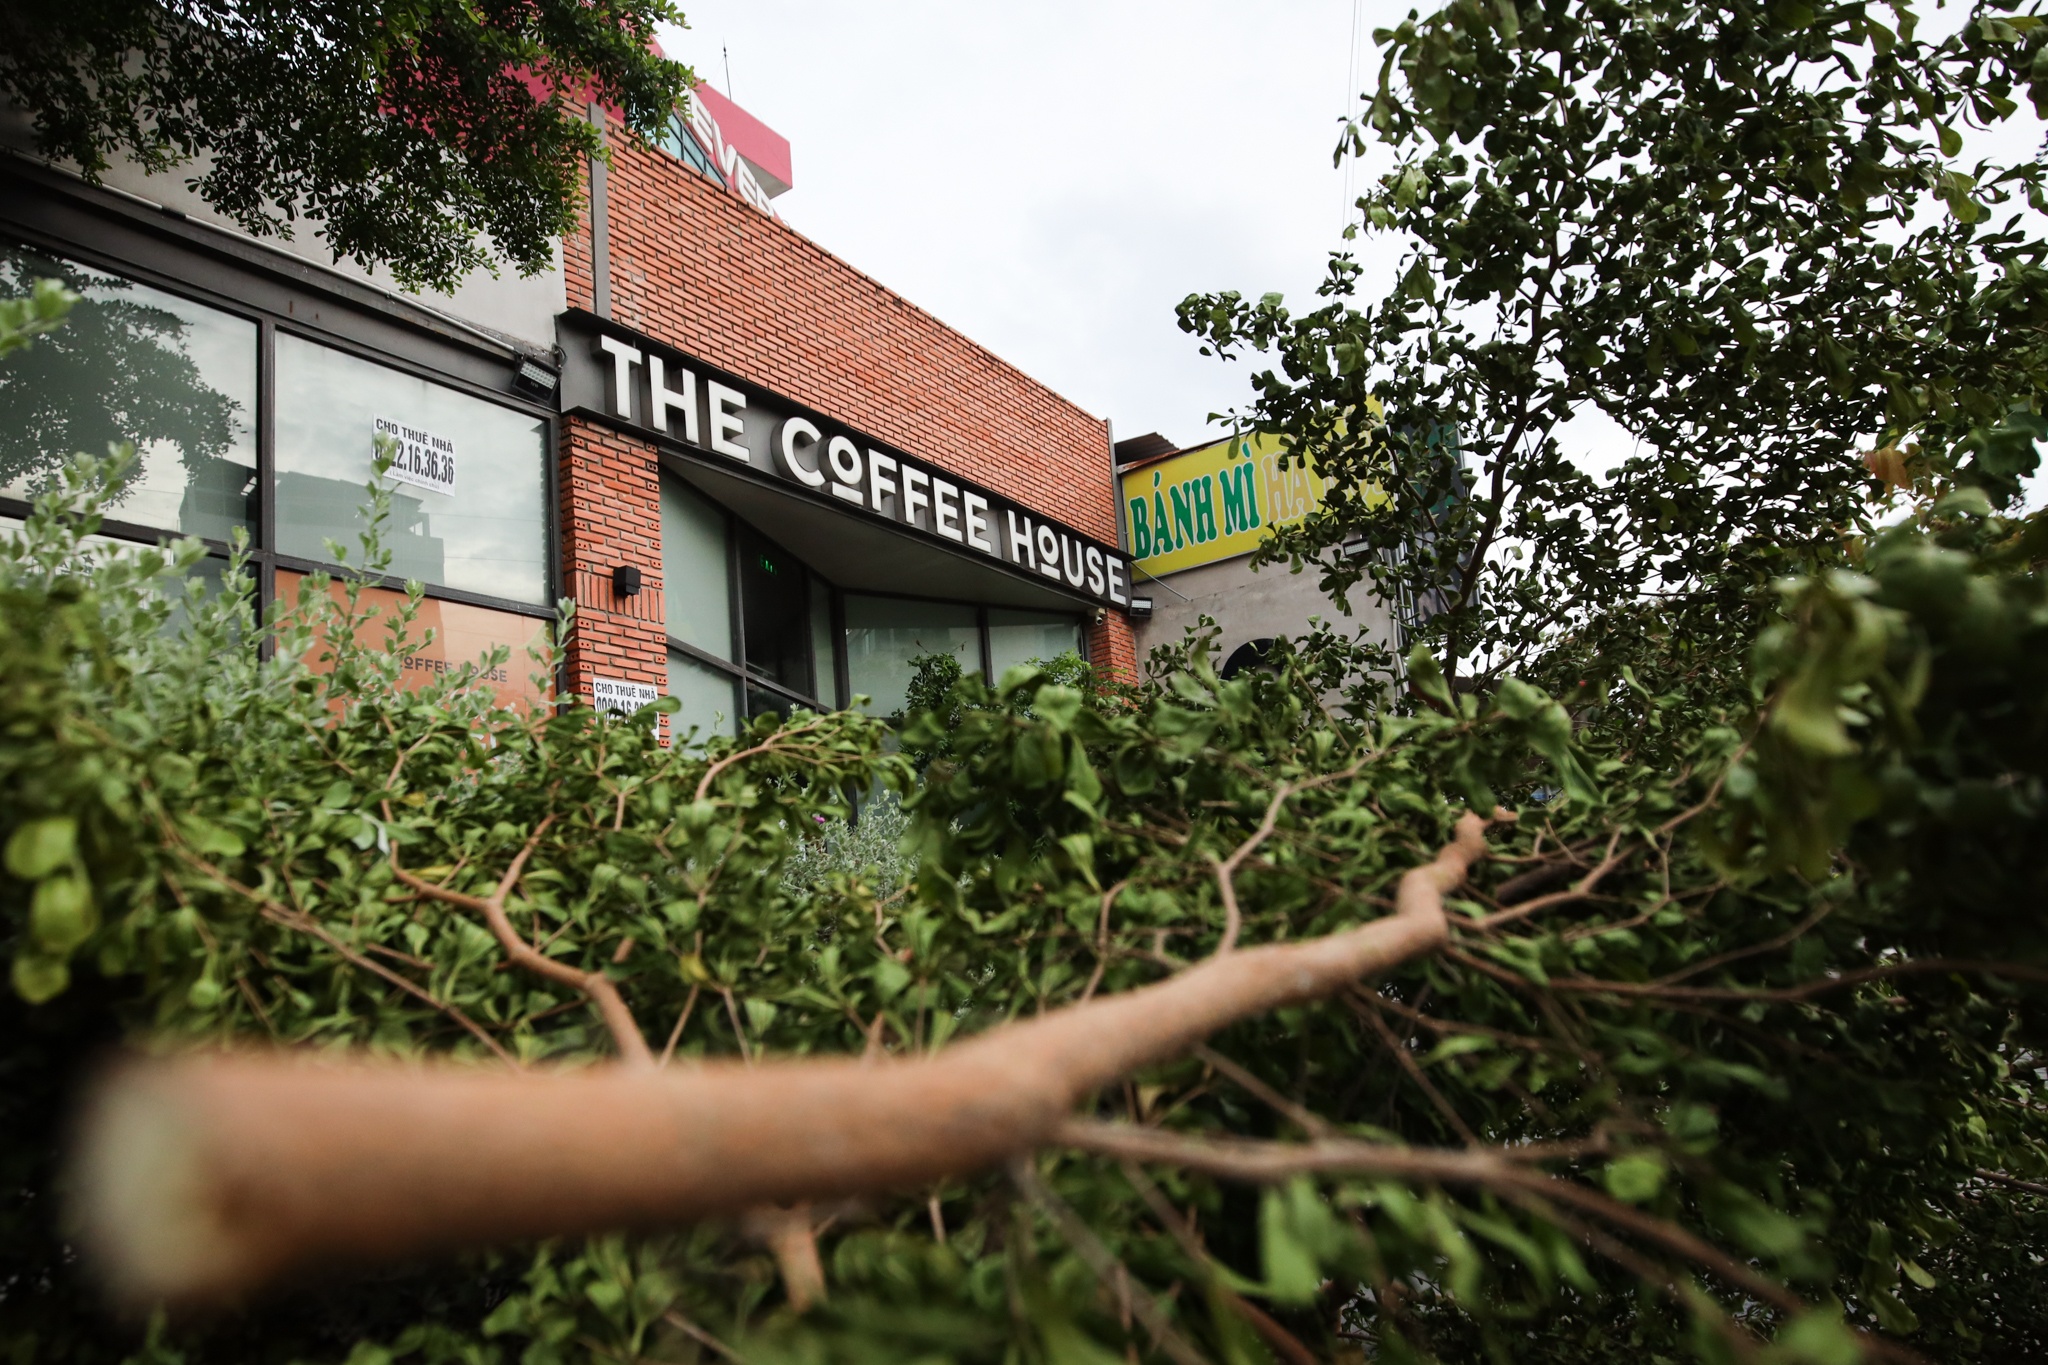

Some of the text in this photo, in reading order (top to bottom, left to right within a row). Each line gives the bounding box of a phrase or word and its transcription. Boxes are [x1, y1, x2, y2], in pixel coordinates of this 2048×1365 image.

[376, 418, 454, 454] CHO THUÊ NHÀ
[601, 334, 1127, 606] THE COFFEE HOUSE
[1129, 470, 1218, 561] BÁNH
[1219, 442, 1261, 537] MÌ
[595, 682, 657, 700] CHO THUÊ NHÀ
